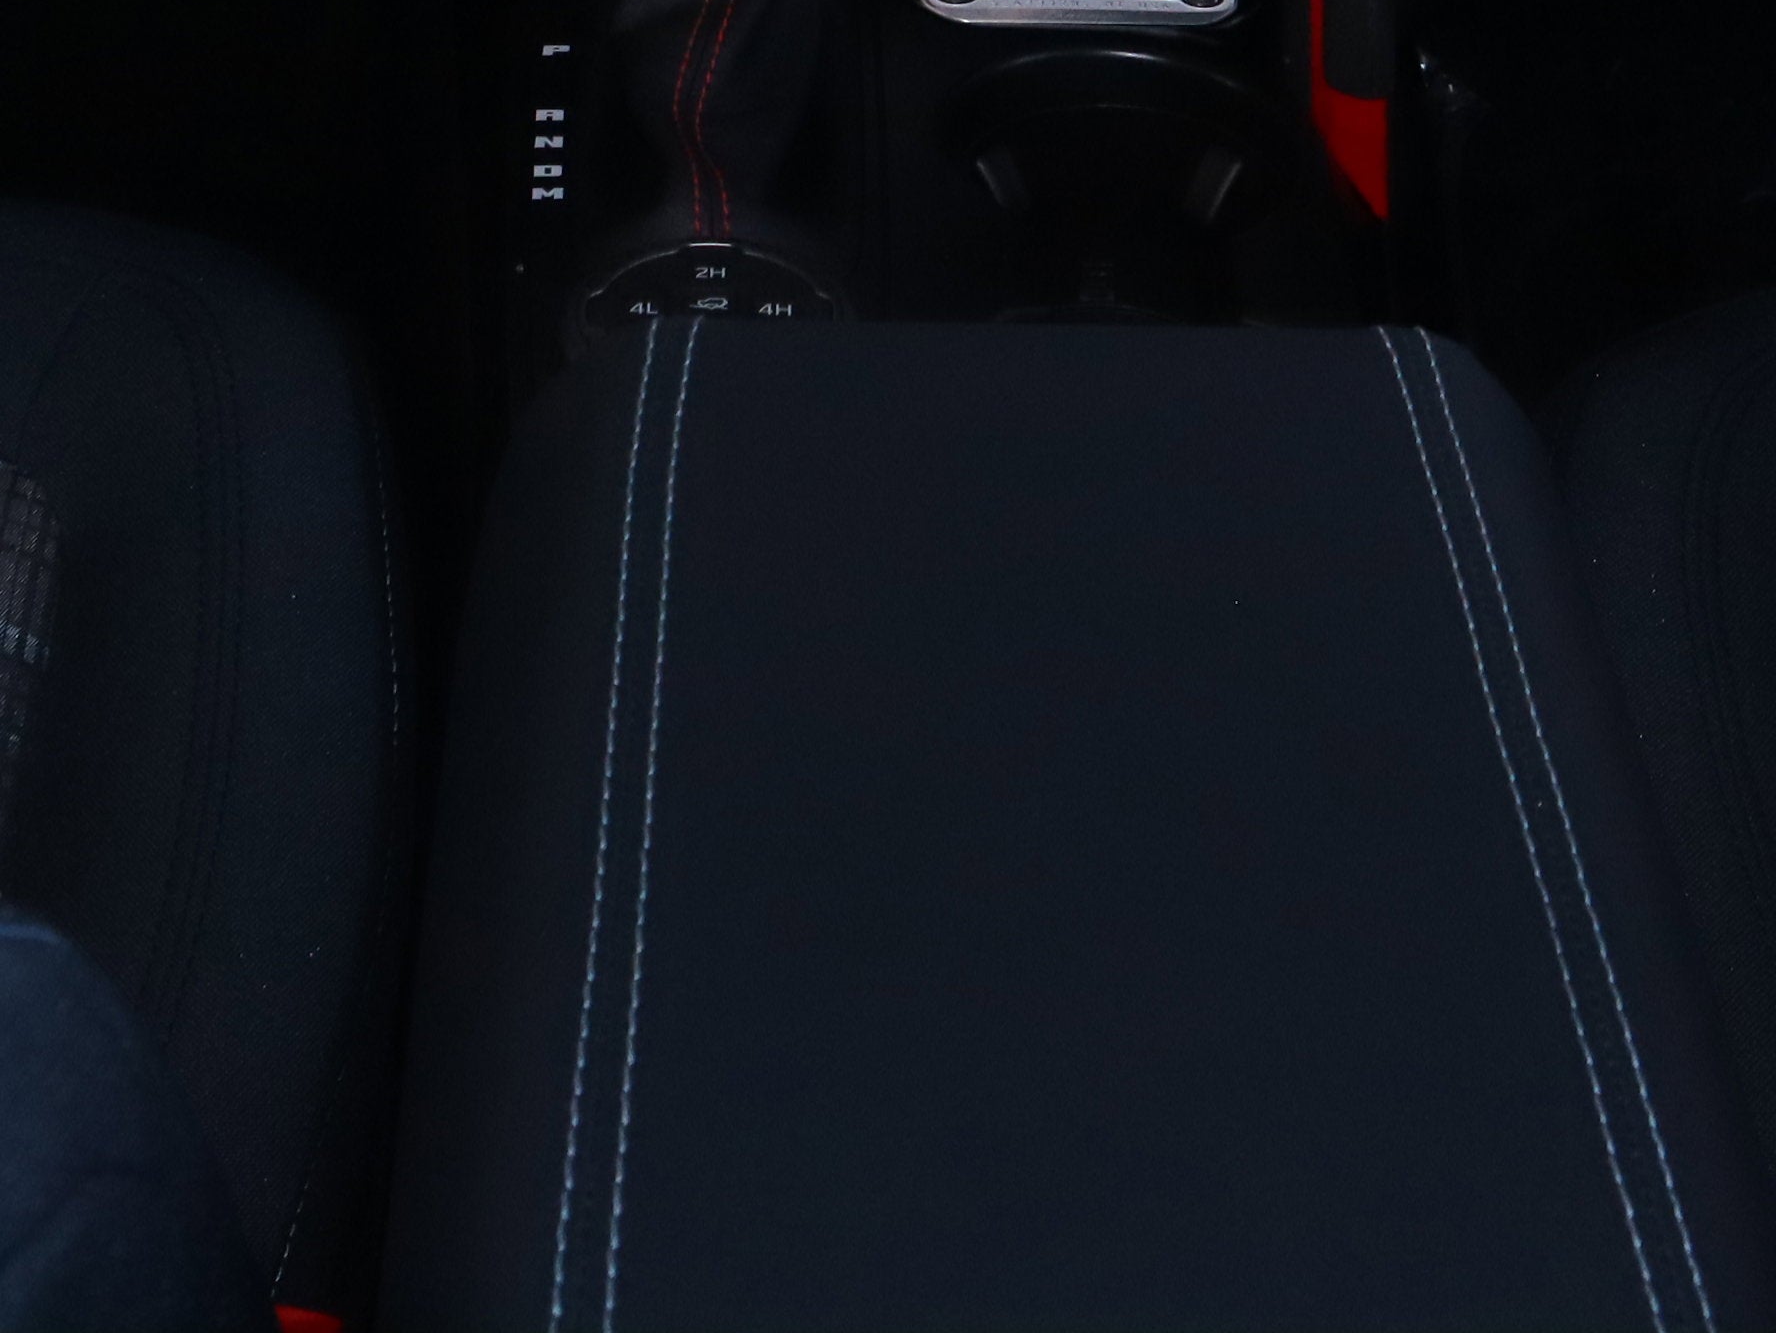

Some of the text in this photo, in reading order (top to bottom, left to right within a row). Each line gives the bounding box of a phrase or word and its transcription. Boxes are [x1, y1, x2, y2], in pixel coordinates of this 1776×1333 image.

[542, 45, 570, 56] P
[534, 136, 564, 148] N
[534, 165, 563, 177] D
[532, 187, 564, 200] M
[695, 267, 726, 279] 2H
[630, 303, 659, 315] 4L
[758, 303, 793, 316] 4H
